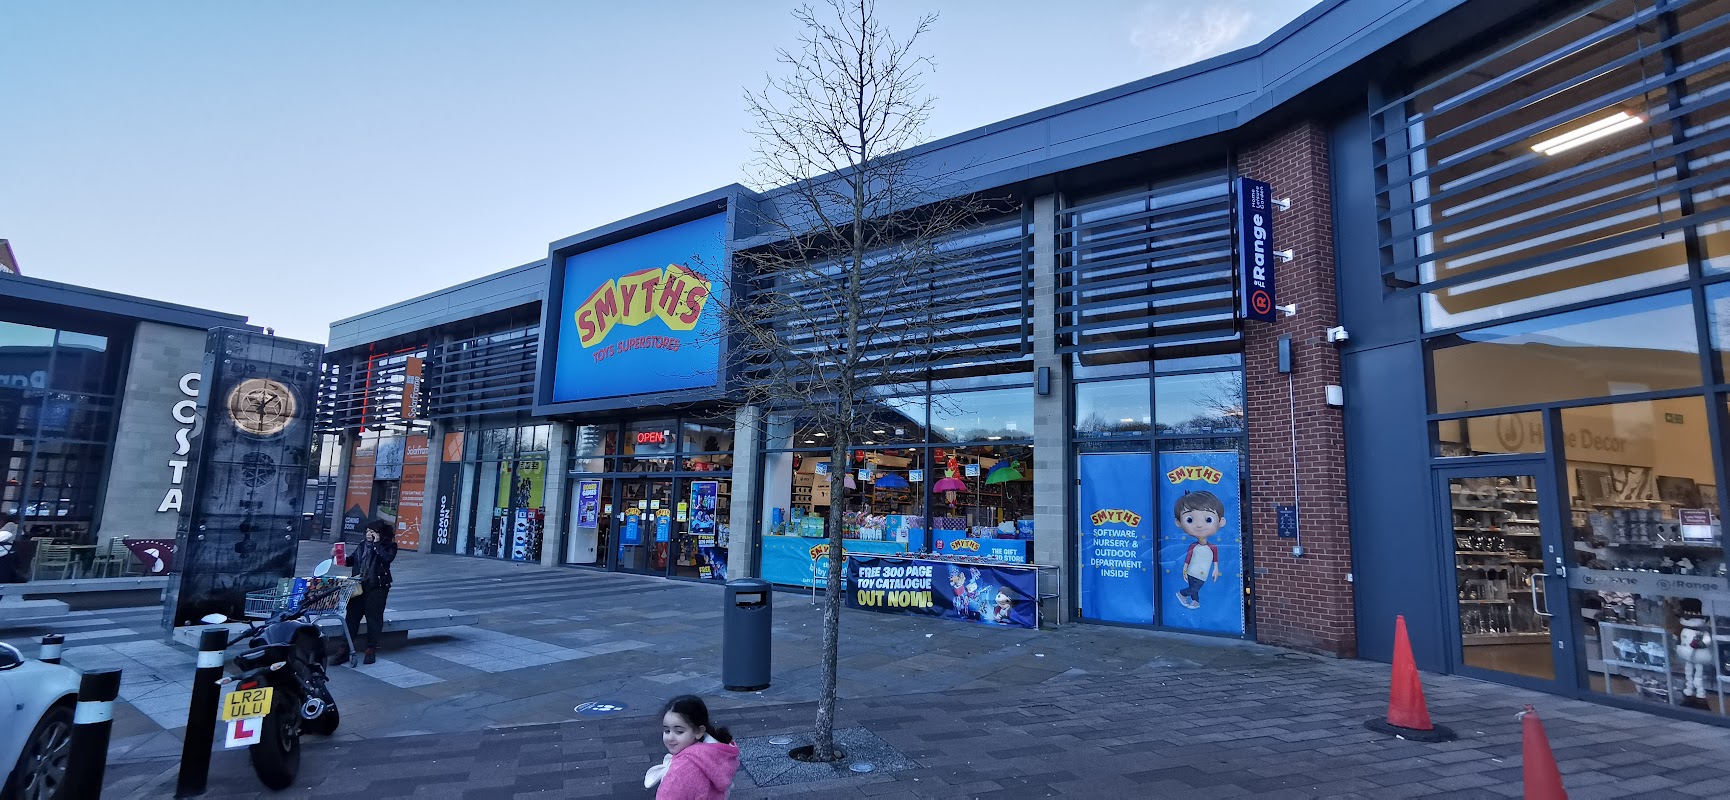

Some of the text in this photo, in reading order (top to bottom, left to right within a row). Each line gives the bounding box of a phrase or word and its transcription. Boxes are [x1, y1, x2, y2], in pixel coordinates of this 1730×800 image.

[1253, 214, 1266, 280] Range
[578, 273, 707, 343] SMYTHS
[593, 336, 680, 363] TOYS SUPERSTORES
[157, 372, 201, 512] COSTA
[638, 432, 662, 442] OPEN
[406, 445, 428, 455] SolarFram
[1168, 467, 1220, 483] SMYTHS
[437, 495, 446, 544] COMING
[1092, 511, 1140, 526] SMYTHS
[441, 510, 450, 544] SOON
[1093, 528, 1138, 539] SOFTWARE,
[951, 540, 979, 550] SMYTHS
[1093, 539, 1130, 548] NURSERY
[1095, 549, 1136, 558] OUTDOOR
[1090, 558, 1142, 568] DEPARTMENT
[858, 566, 881, 578] FREE
[882, 566, 904, 578] 300
[906, 566, 933, 577] PAGE
[1101, 570, 1129, 578] INSIDE
[857, 579, 874, 589] TOY
[875, 578, 932, 590] CATALOGUE
[1676, 580, 1719, 591] Range
[857, 590, 933, 608] OUT NOW!
[231, 690, 266, 704] LR21
[231, 703, 262, 717] ULU
[234, 720, 253, 739] L
